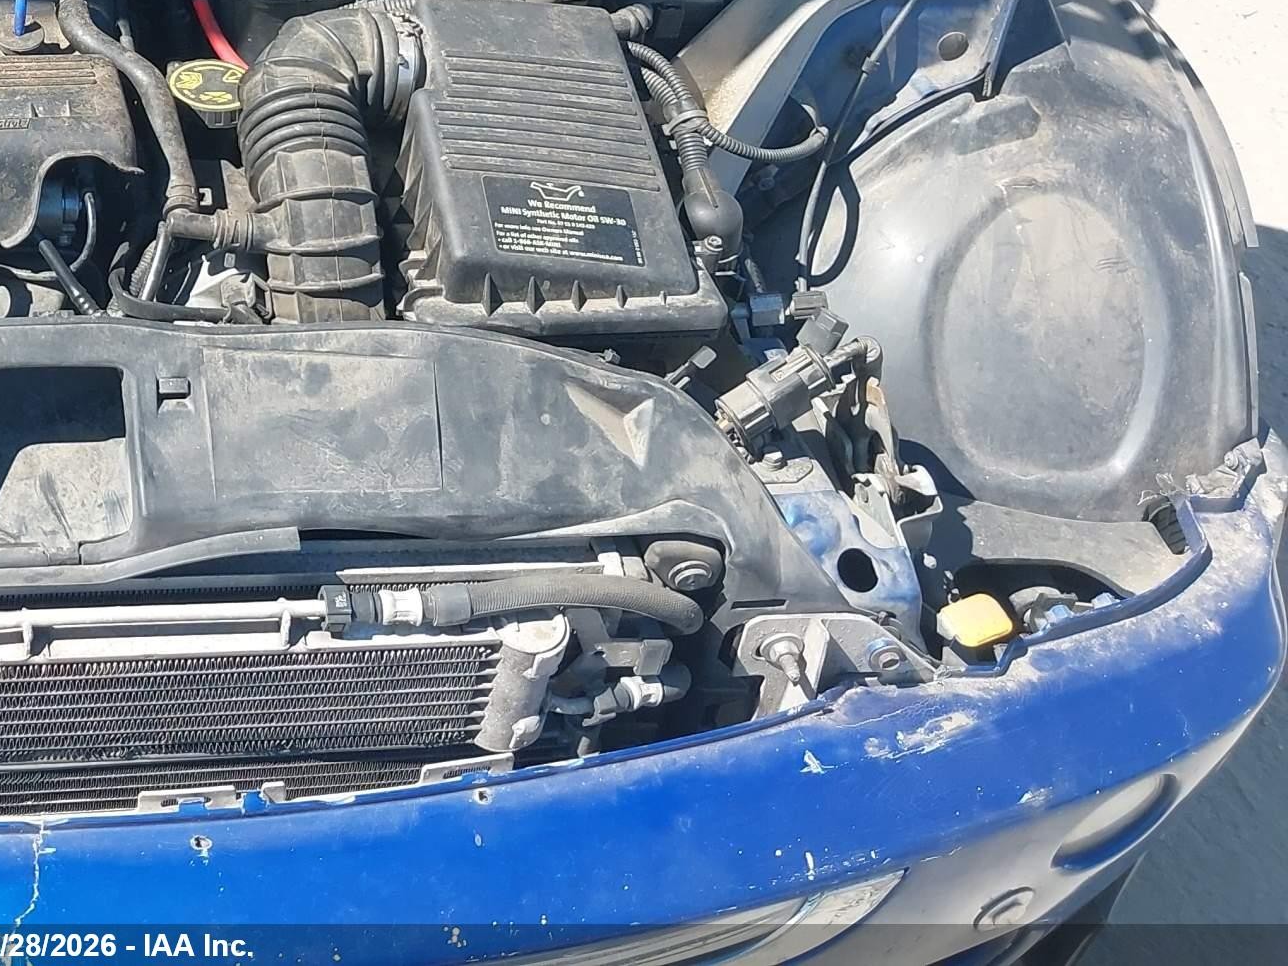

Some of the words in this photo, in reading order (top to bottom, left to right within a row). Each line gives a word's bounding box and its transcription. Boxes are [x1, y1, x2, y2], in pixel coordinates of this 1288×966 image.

[527, 199, 543, 208] We
[544, 201, 596, 213] Recommend
[500, 206, 521, 214] MINI
[522, 208, 560, 219] Synthetic
[561, 212, 586, 221] Motor
[600, 217, 627, 226] 5W-30
